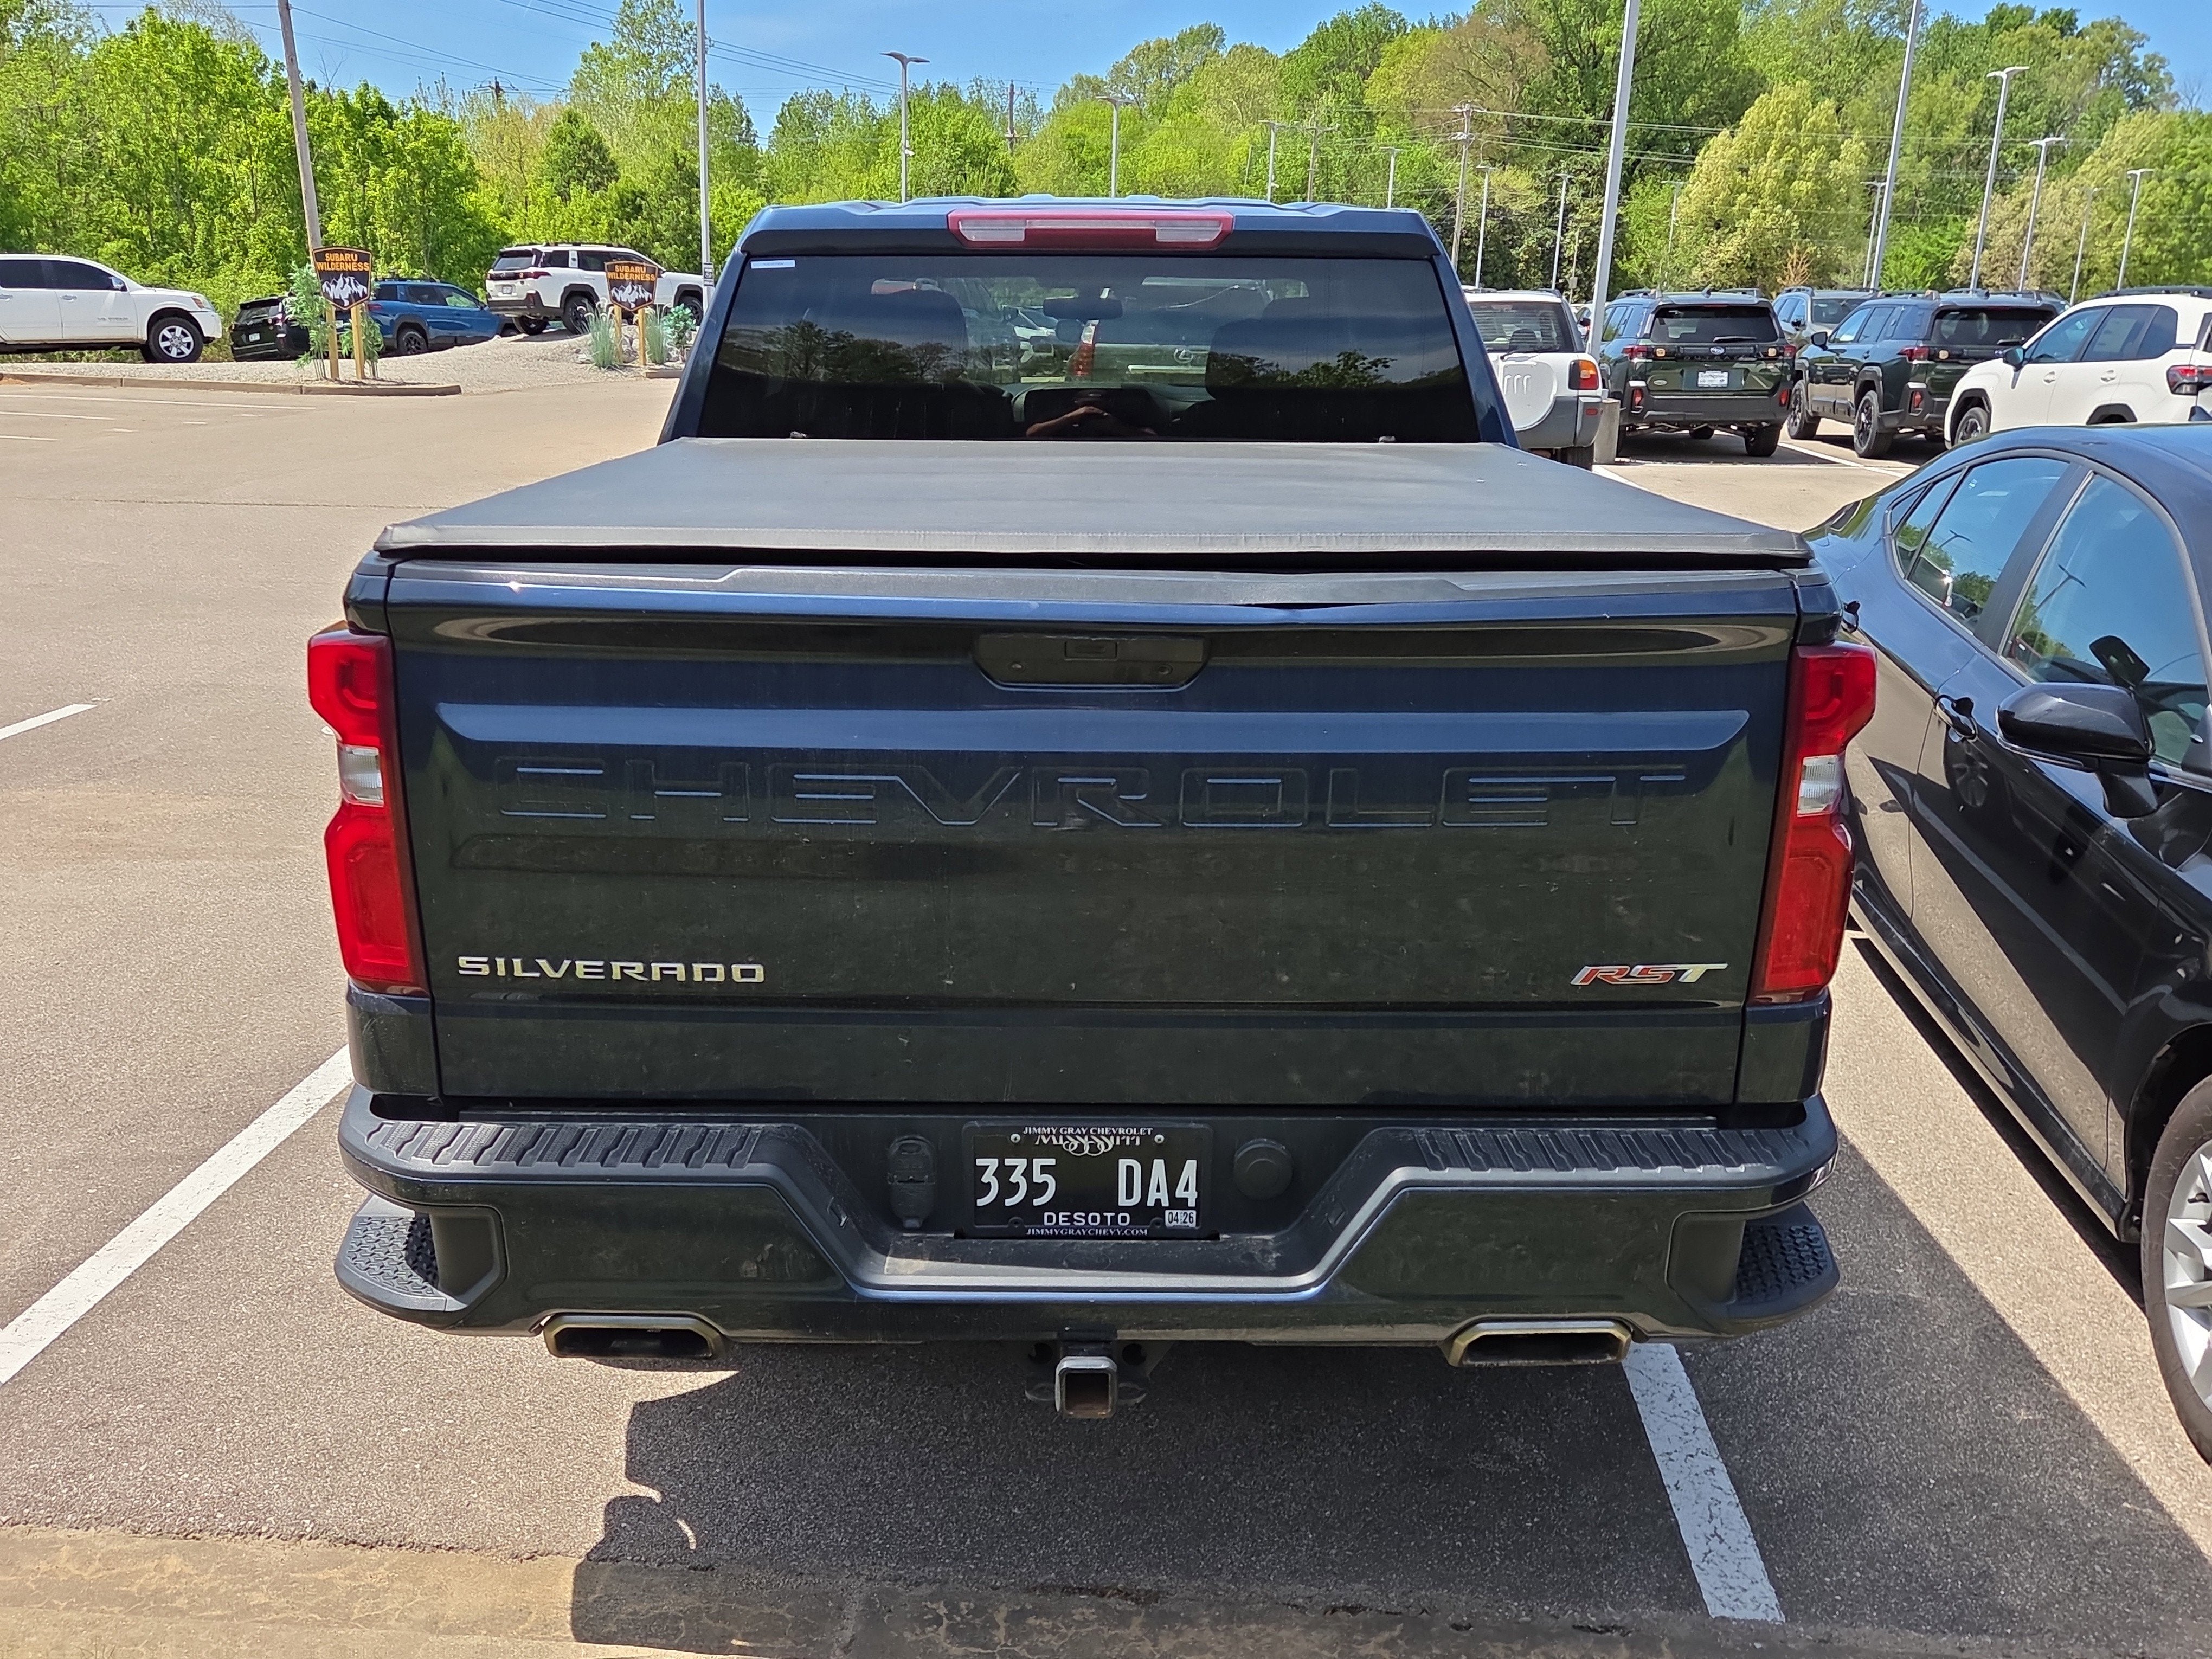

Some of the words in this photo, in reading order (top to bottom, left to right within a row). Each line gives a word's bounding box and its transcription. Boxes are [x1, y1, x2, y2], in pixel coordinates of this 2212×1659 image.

[325, 253, 358, 262] SUBARU
[317, 262, 370, 271] WILDERNESS
[615, 265, 646, 273] SUBARU
[608, 272, 656, 281] WILDERNESS
[496, 757, 1687, 827] CHEVROLET
[458, 956, 766, 983] SILVERADO
[1570, 963, 1728, 986] RST
[1023, 1127, 1058, 1135] JIMMY
[1059, 1127, 1088, 1135] GRAY
[1090, 1127, 1153, 1135] CHEVROLET
[975, 1158, 1057, 1206] 335
[1118, 1159, 1198, 1207] DA4
[1044, 1212, 1131, 1226] DESOTO
[1168, 1212, 1179, 1224] 04
[1182, 1212, 1194, 1224] 26
[1026, 1227, 1148, 1237] JIMMYGRAYCHEVY.COM
